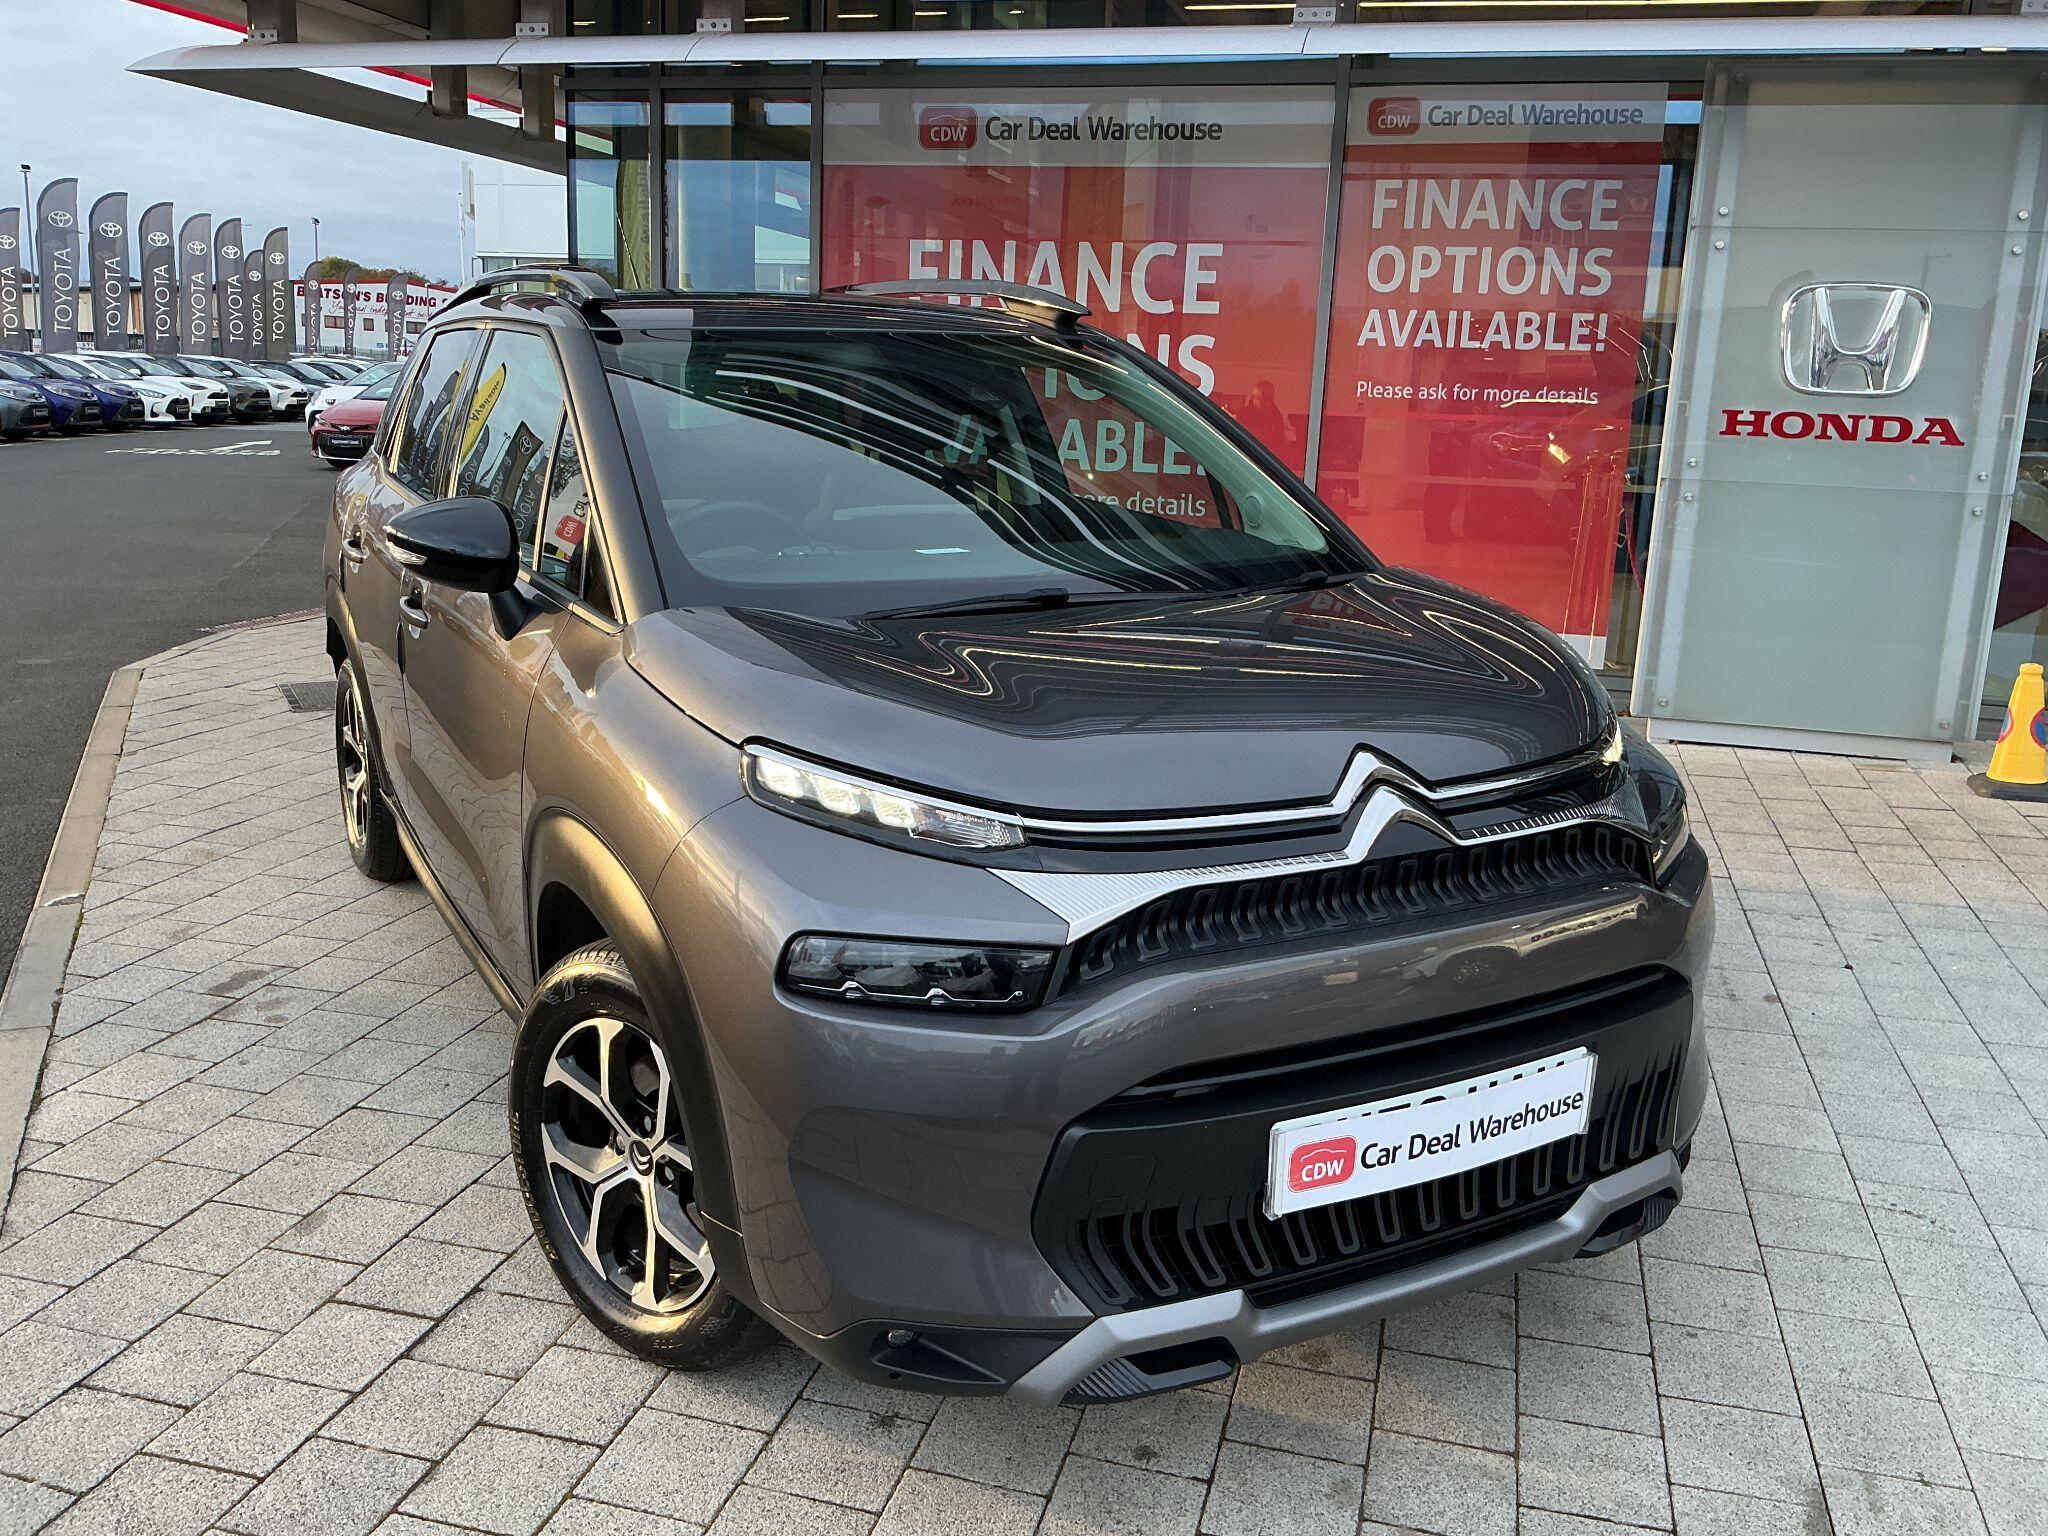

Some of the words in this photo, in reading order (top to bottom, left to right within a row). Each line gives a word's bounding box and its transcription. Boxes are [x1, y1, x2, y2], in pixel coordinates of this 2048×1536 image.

[930, 126, 967, 142] CDW
[985, 115, 1023, 141] Car
[1028, 115, 1080, 141] Deal
[1087, 115, 1223, 141] Warehouse
[1377, 114, 1412, 129] CDW
[1427, 105, 1463, 127] Car
[1467, 103, 1515, 126] Deal
[1522, 103, 1645, 126] Warehouse
[1371, 178, 1624, 232] FINANCE
[53, 248, 73, 333] TOYOTA
[104, 257, 122, 336] TOYOTA
[297, 286, 372, 302] BTSN'S
[376, 292, 437, 308] BDING
[908, 239, 1225, 315] FINANCE
[1367, 245, 1615, 296] OPTIONS
[1, 266, 19, 338] TOYOTA
[154, 264, 171, 341] TOYOTA
[191, 272, 206, 345] TOYOTA
[227, 274, 245, 343] TOYOTA
[252, 293, 264, 347] TOYOTA
[272, 279, 286, 342] TOYOTA
[1356, 308, 1610, 352] AVAILABLE!
[1356, 381, 1414, 399] Please
[1418, 383, 1448, 400] ask
[1453, 384, 1479, 401] for
[1483, 388, 1531, 403] more
[1535, 386, 1599, 404] details
[1719, 409, 1965, 446] HONDA
[1127, 490, 1206, 517] details
[1301, 1158, 1345, 1182] CDW
[1360, 1142, 1403, 1169] Car
[1408, 1124, 1461, 1160] Deal
[1468, 1091, 1585, 1144] Warehouse
